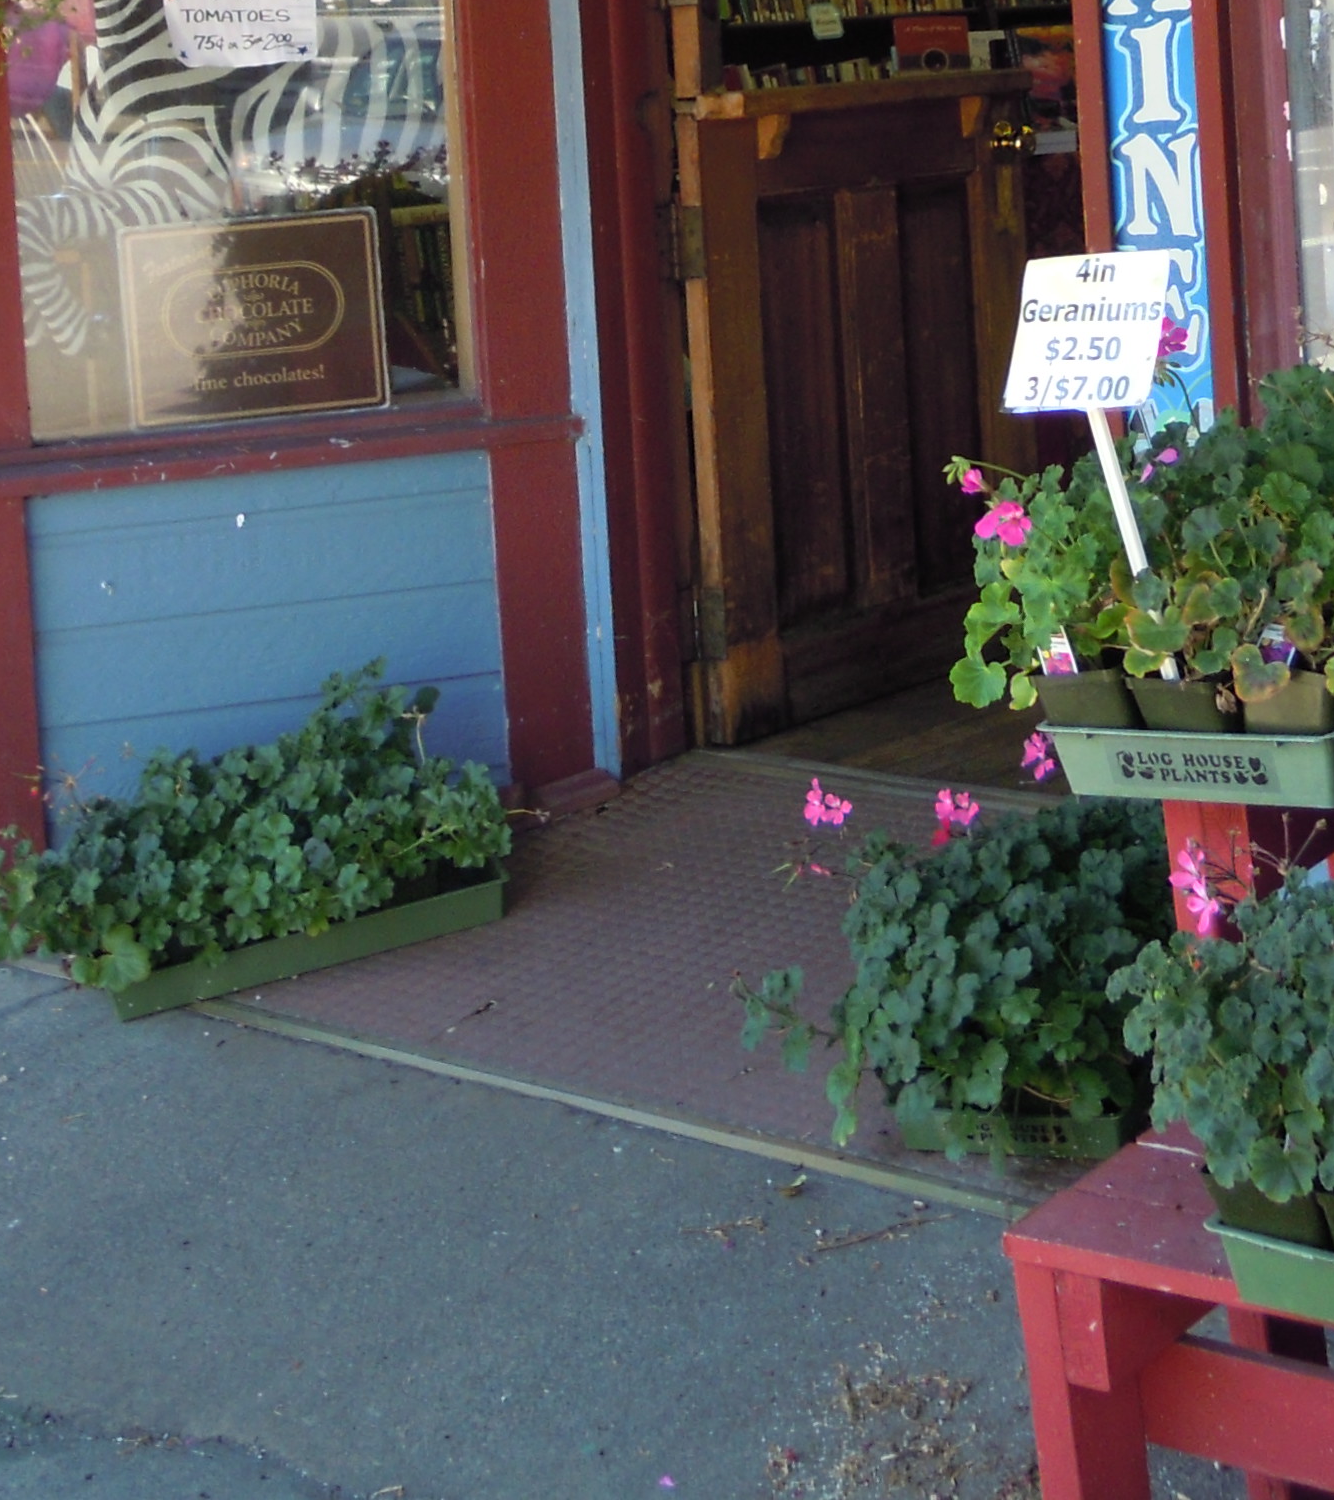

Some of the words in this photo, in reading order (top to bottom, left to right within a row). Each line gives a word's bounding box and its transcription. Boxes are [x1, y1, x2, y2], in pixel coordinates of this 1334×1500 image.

[180, 8, 291, 23] TOMATOES
[1075, 257, 1117, 284] 4in
[197, 297, 315, 324] CHOCOLATE
[1022, 296, 1162, 324] Geraniums
[209, 318, 304, 348] COMPANY
[1045, 336, 1123, 364] $2.50
[233, 363, 327, 388] chocolates!
[1024, 375, 1131, 406] 3/$7.00
[1137, 751, 1173, 766] LOG
[1183, 753, 1245, 771] HOUSE
[1160, 767, 1232, 784] PLANTS
